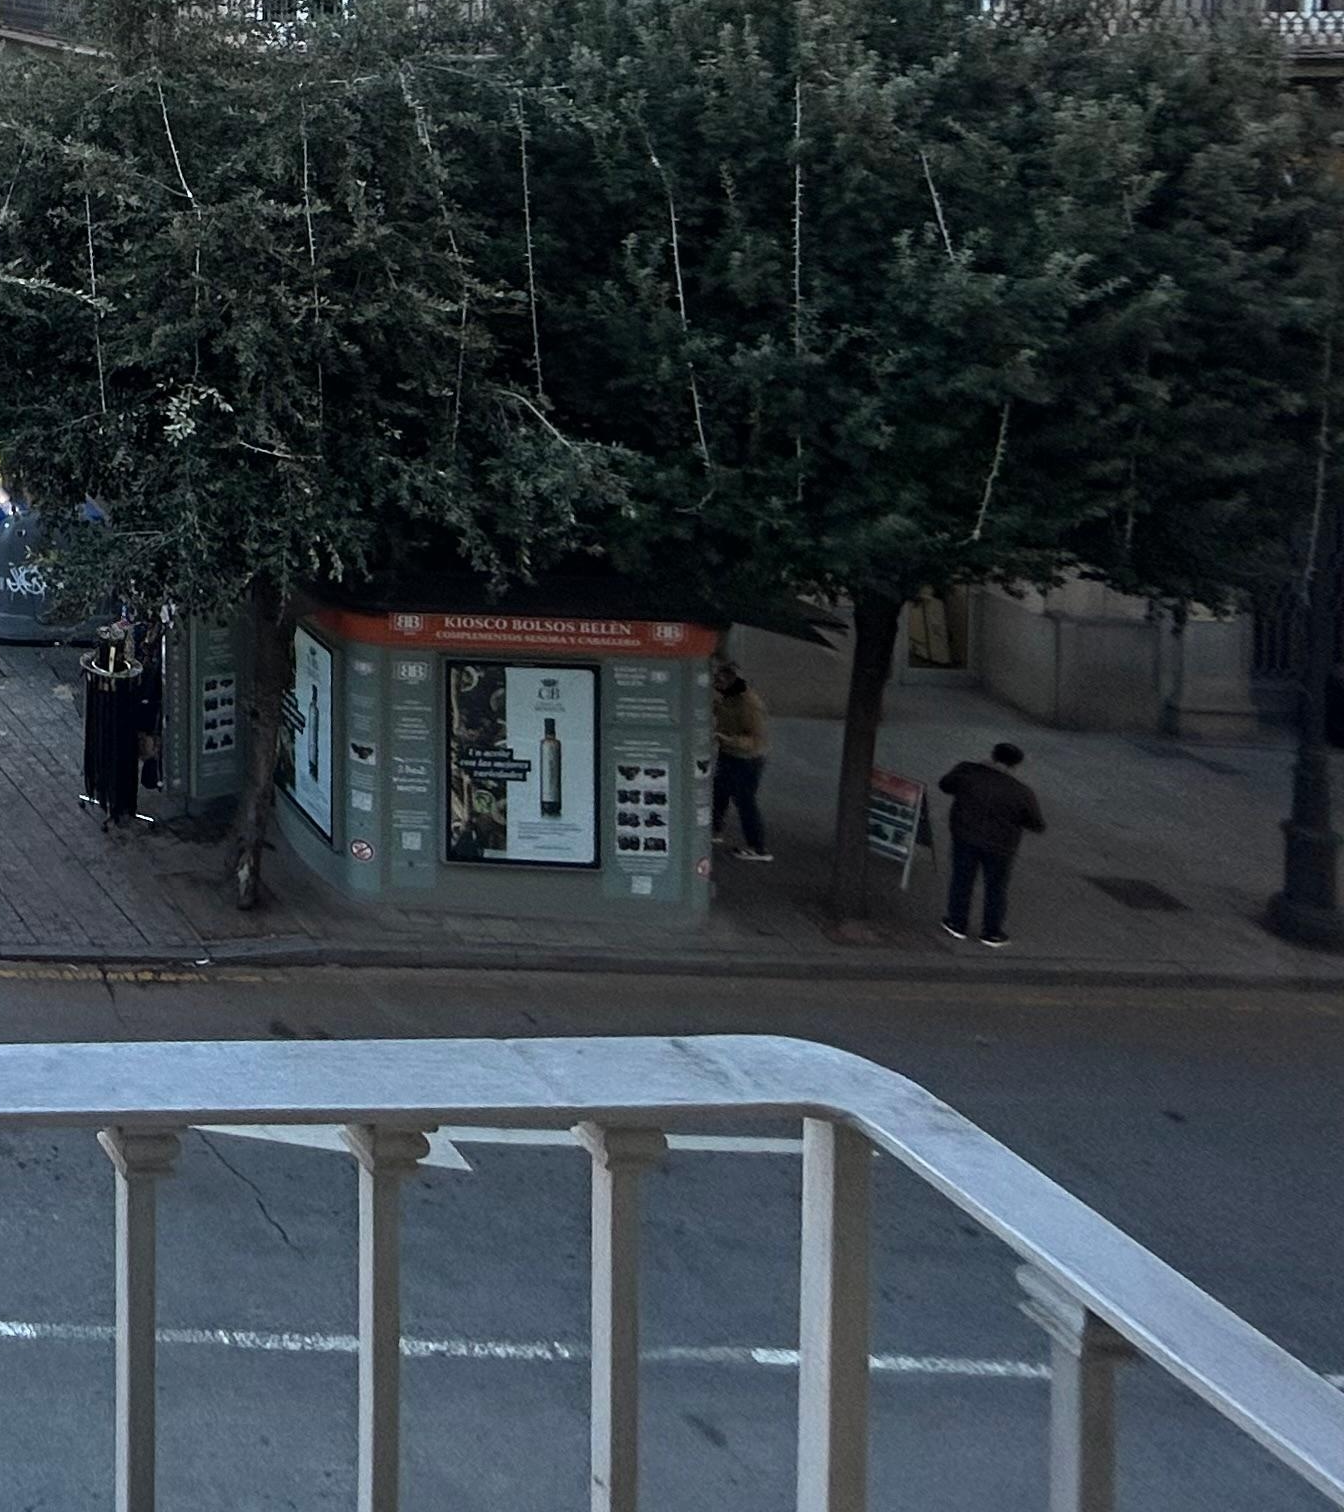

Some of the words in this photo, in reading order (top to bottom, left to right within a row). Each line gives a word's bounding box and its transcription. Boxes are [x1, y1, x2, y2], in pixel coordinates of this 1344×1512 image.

[443, 615, 508, 630] KIOSCO
[511, 618, 576, 634] BOLSOS
[435, 630, 523, 642] COMPLEMENTOS
[575, 636, 642, 647] CABALLERO
